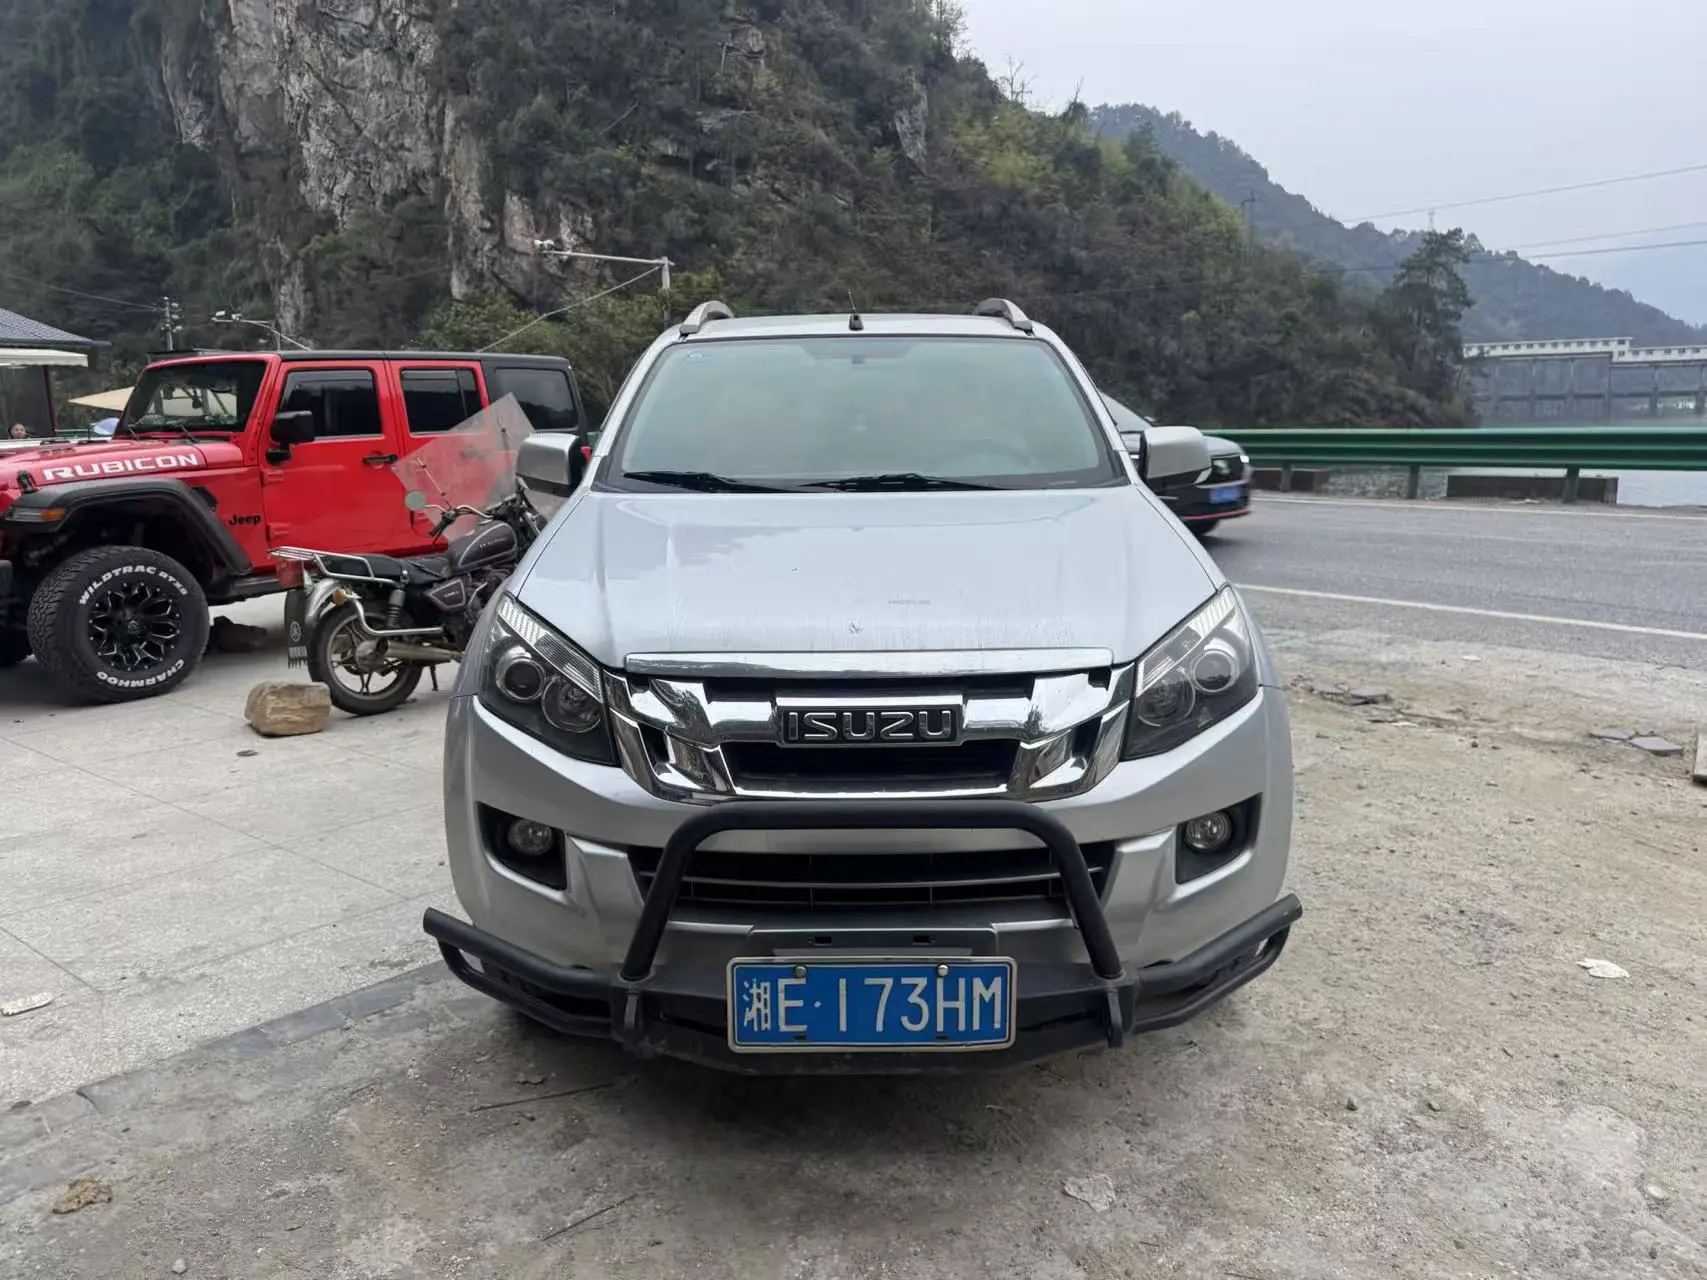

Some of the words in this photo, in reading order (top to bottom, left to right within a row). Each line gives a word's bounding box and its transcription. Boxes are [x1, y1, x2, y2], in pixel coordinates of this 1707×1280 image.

[42, 453, 199, 481] RUBICON
[228, 514, 261, 526] Jeep
[79, 565, 158, 605] WILDTRAC
[96, 659, 185, 688] CHARMHOO
[788, 710, 951, 740] ISUZU
